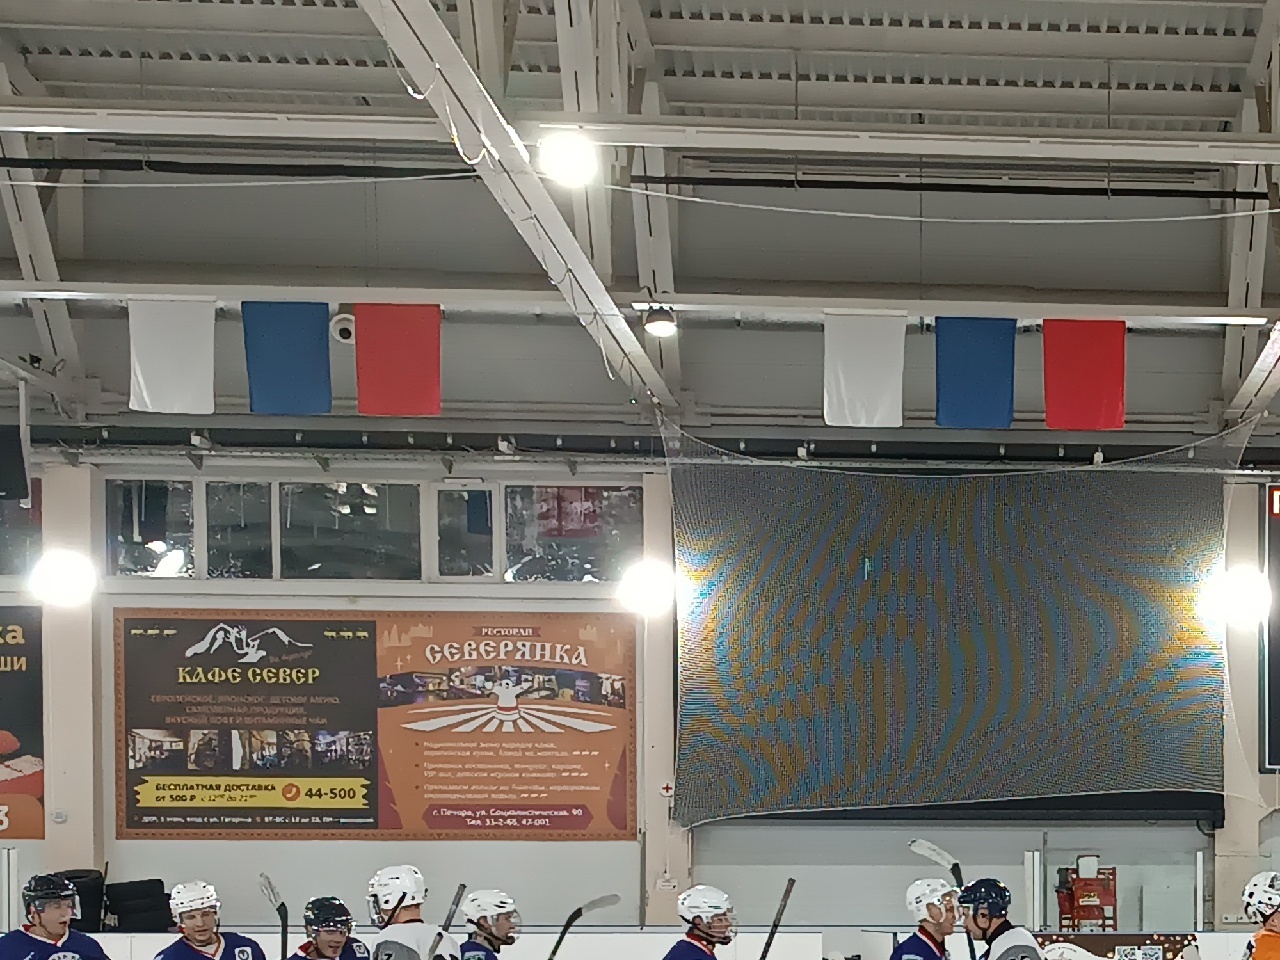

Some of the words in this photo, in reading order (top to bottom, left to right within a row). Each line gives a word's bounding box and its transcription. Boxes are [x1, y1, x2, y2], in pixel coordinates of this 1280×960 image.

[482, 628, 533, 636] РЕСТОРАН
[425, 640, 588, 666] СЕВЕРЯНКА
[178, 667, 241, 683] КАФЕ
[248, 667, 320, 684] СЕВЕР
[156, 783, 221, 791] БЕСПЛАТНАЯ
[224, 783, 276, 792] ДОСТАВКА
[169, 794, 187, 802] 500
[305, 788, 356, 800] 44-500
